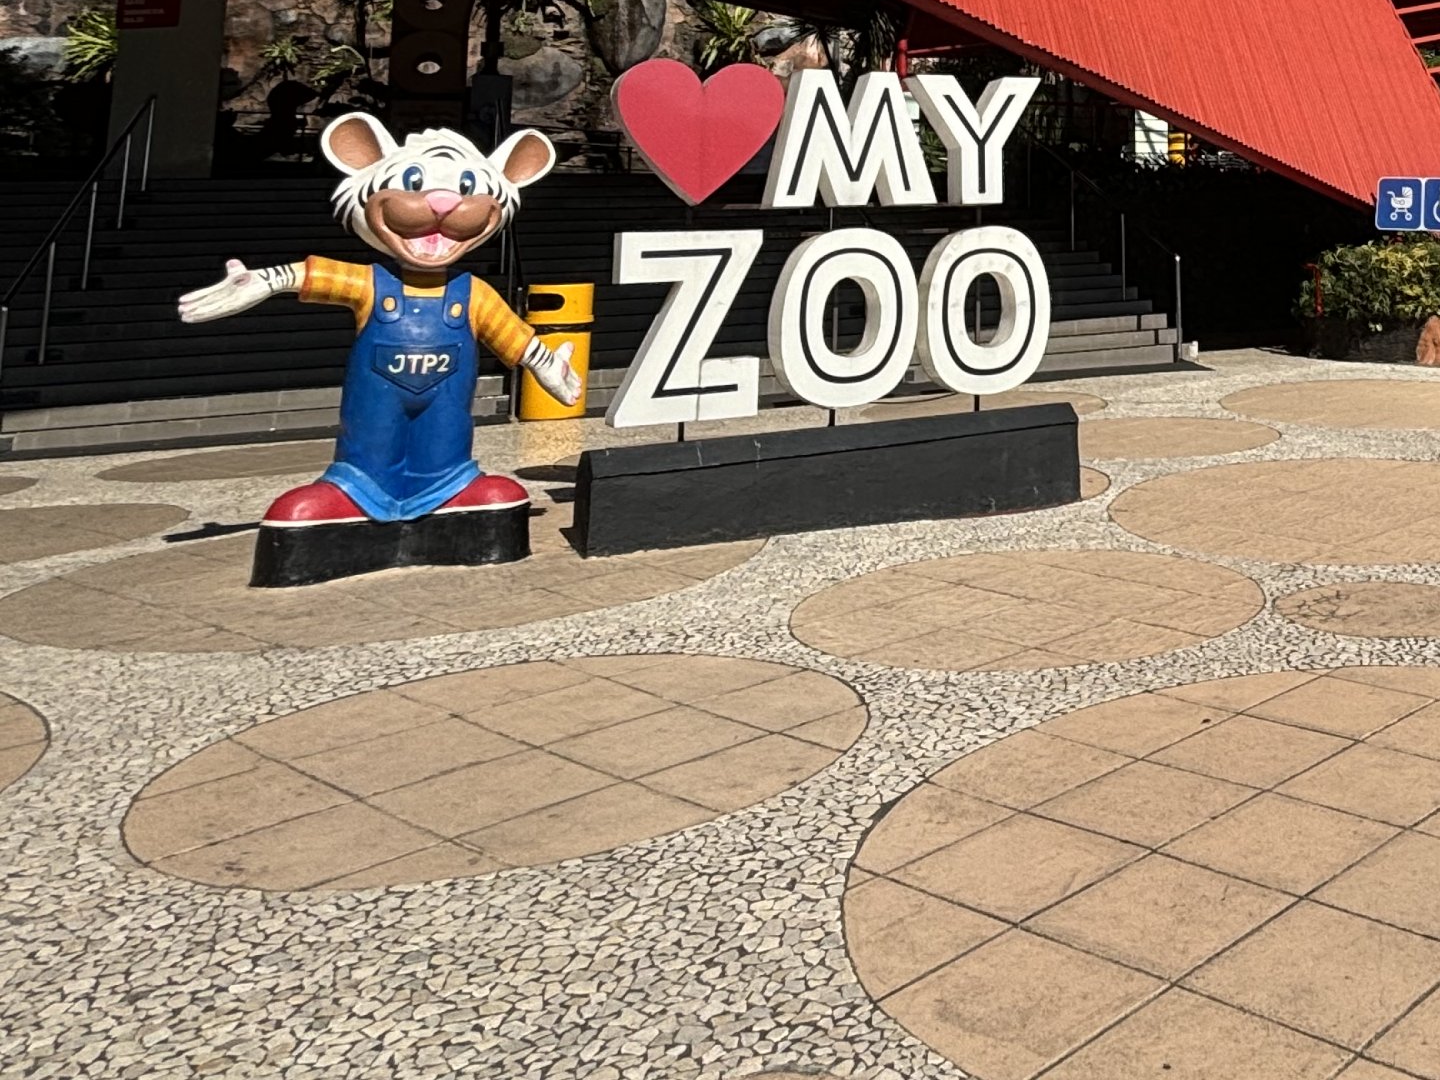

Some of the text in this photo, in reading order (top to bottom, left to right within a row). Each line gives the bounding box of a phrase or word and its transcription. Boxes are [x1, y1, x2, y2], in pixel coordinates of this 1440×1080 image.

[763, 69, 1041, 208] MY
[388, 354, 450, 374] JTP2
[606, 226, 1051, 428] ZOO
